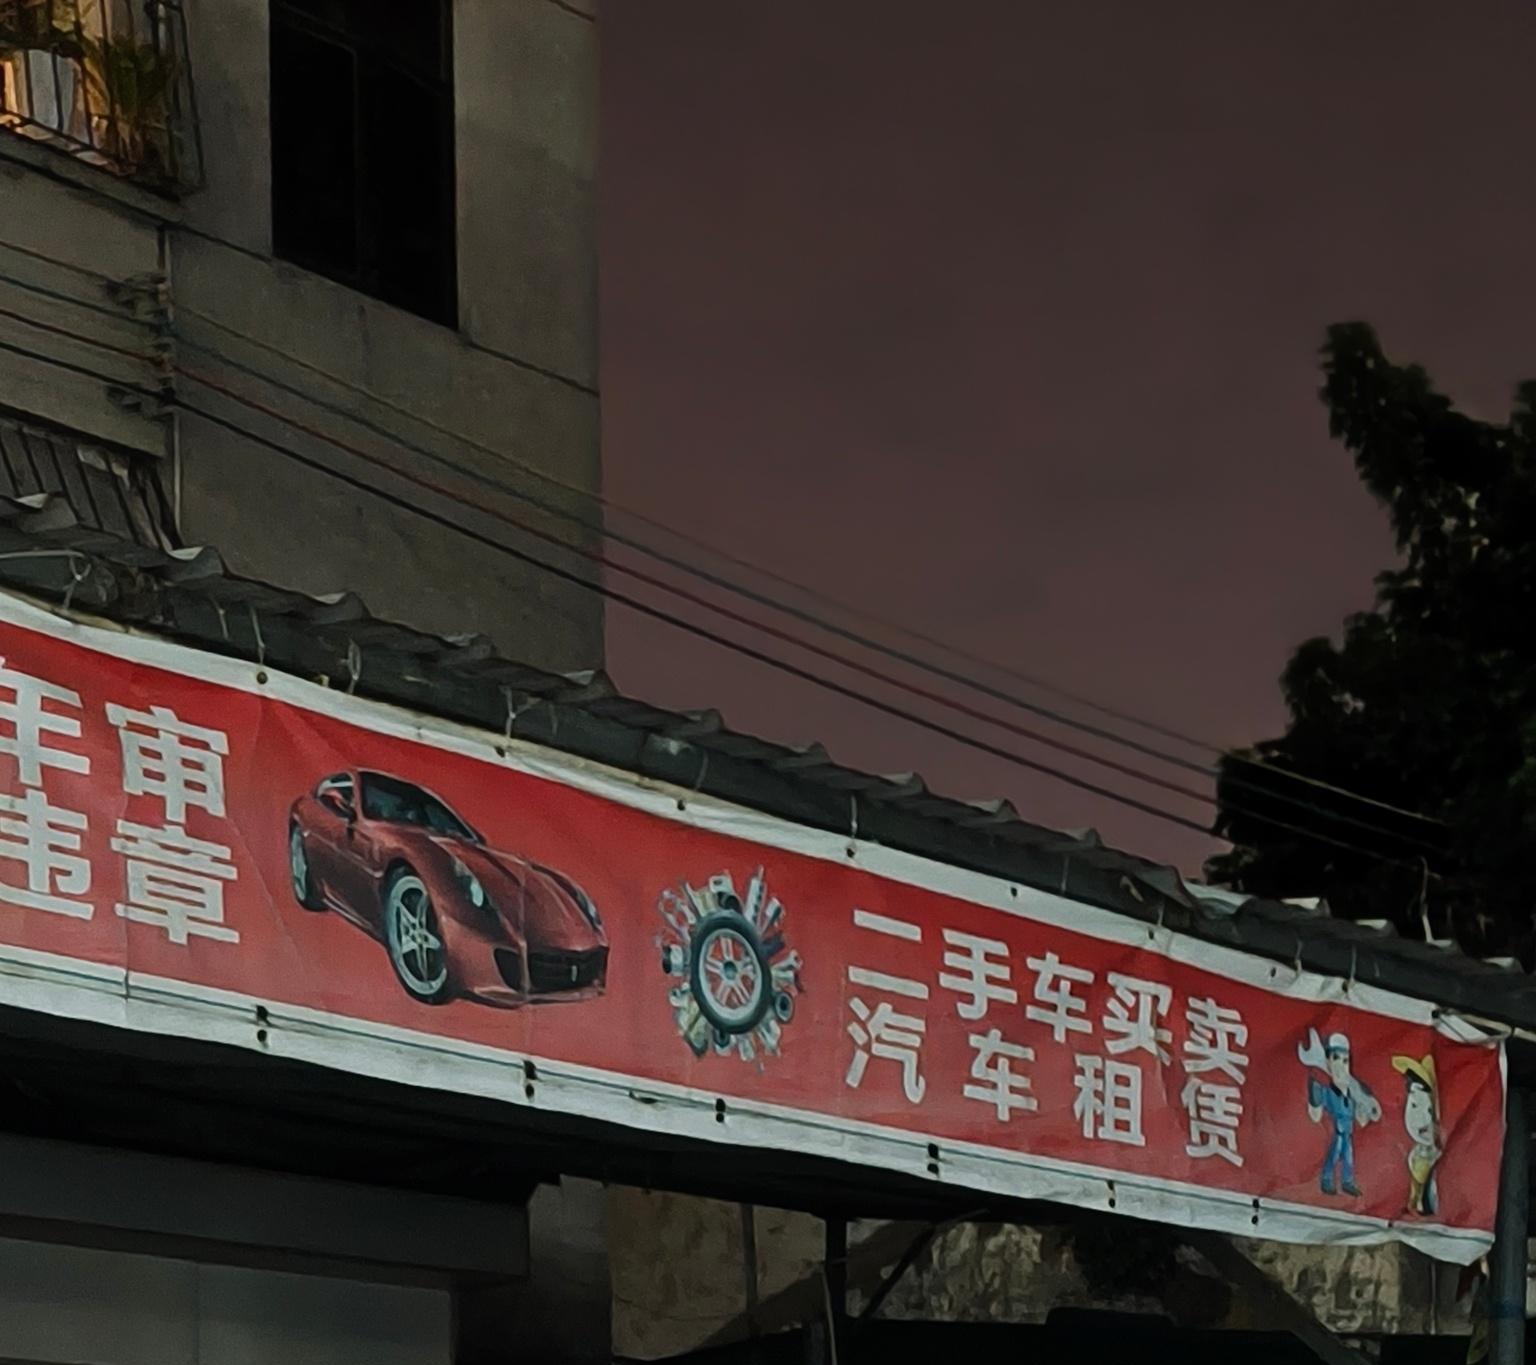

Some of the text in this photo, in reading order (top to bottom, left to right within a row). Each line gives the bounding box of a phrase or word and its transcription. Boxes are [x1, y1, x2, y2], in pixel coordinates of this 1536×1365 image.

[846, 996, 1245, 1168] 汽车租赁
[847, 908, 1250, 1086] 二手车买卖
